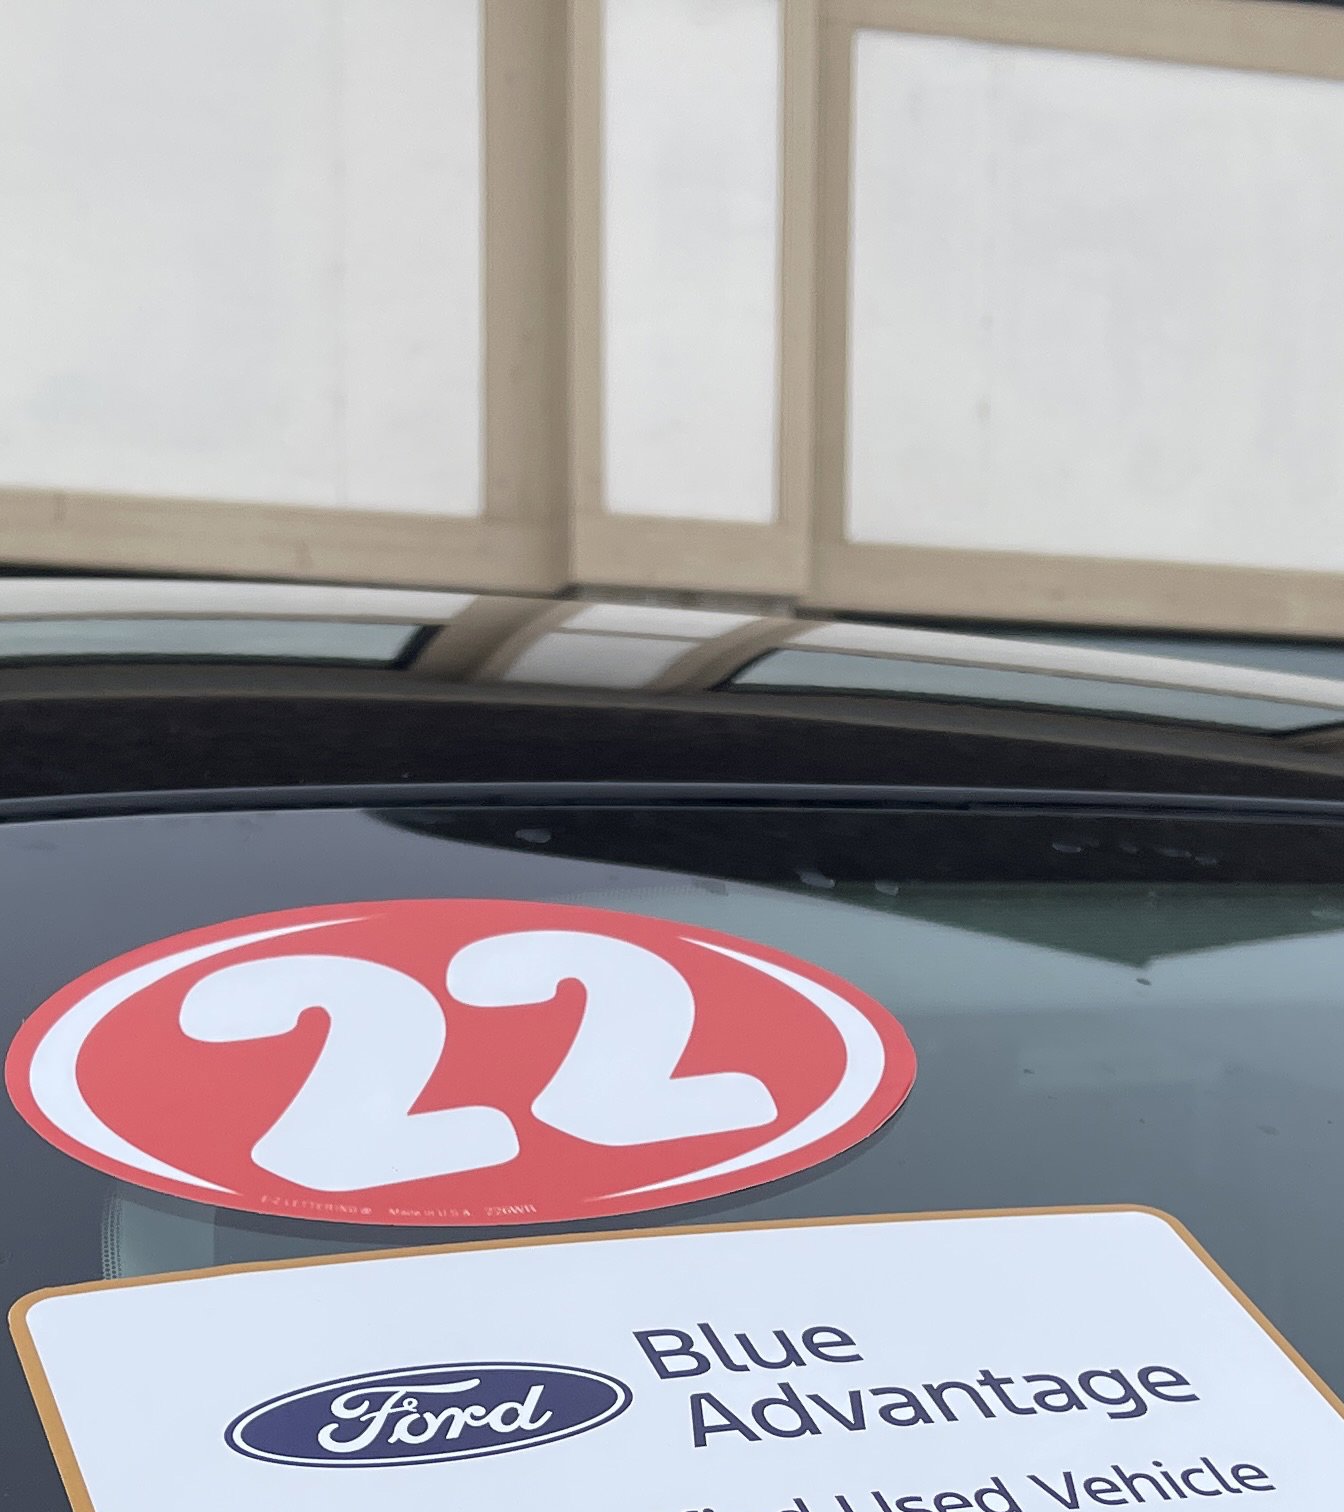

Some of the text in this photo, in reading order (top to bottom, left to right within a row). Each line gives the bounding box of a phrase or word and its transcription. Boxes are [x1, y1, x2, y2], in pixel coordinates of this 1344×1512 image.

[179, 930, 778, 1192] 22
[632, 1323, 864, 1380] Blue
[317, 1378, 552, 1453] Ford
[689, 1366, 1201, 1448] Advantage
[1026, 1457, 1277, 1510] Vehicle
